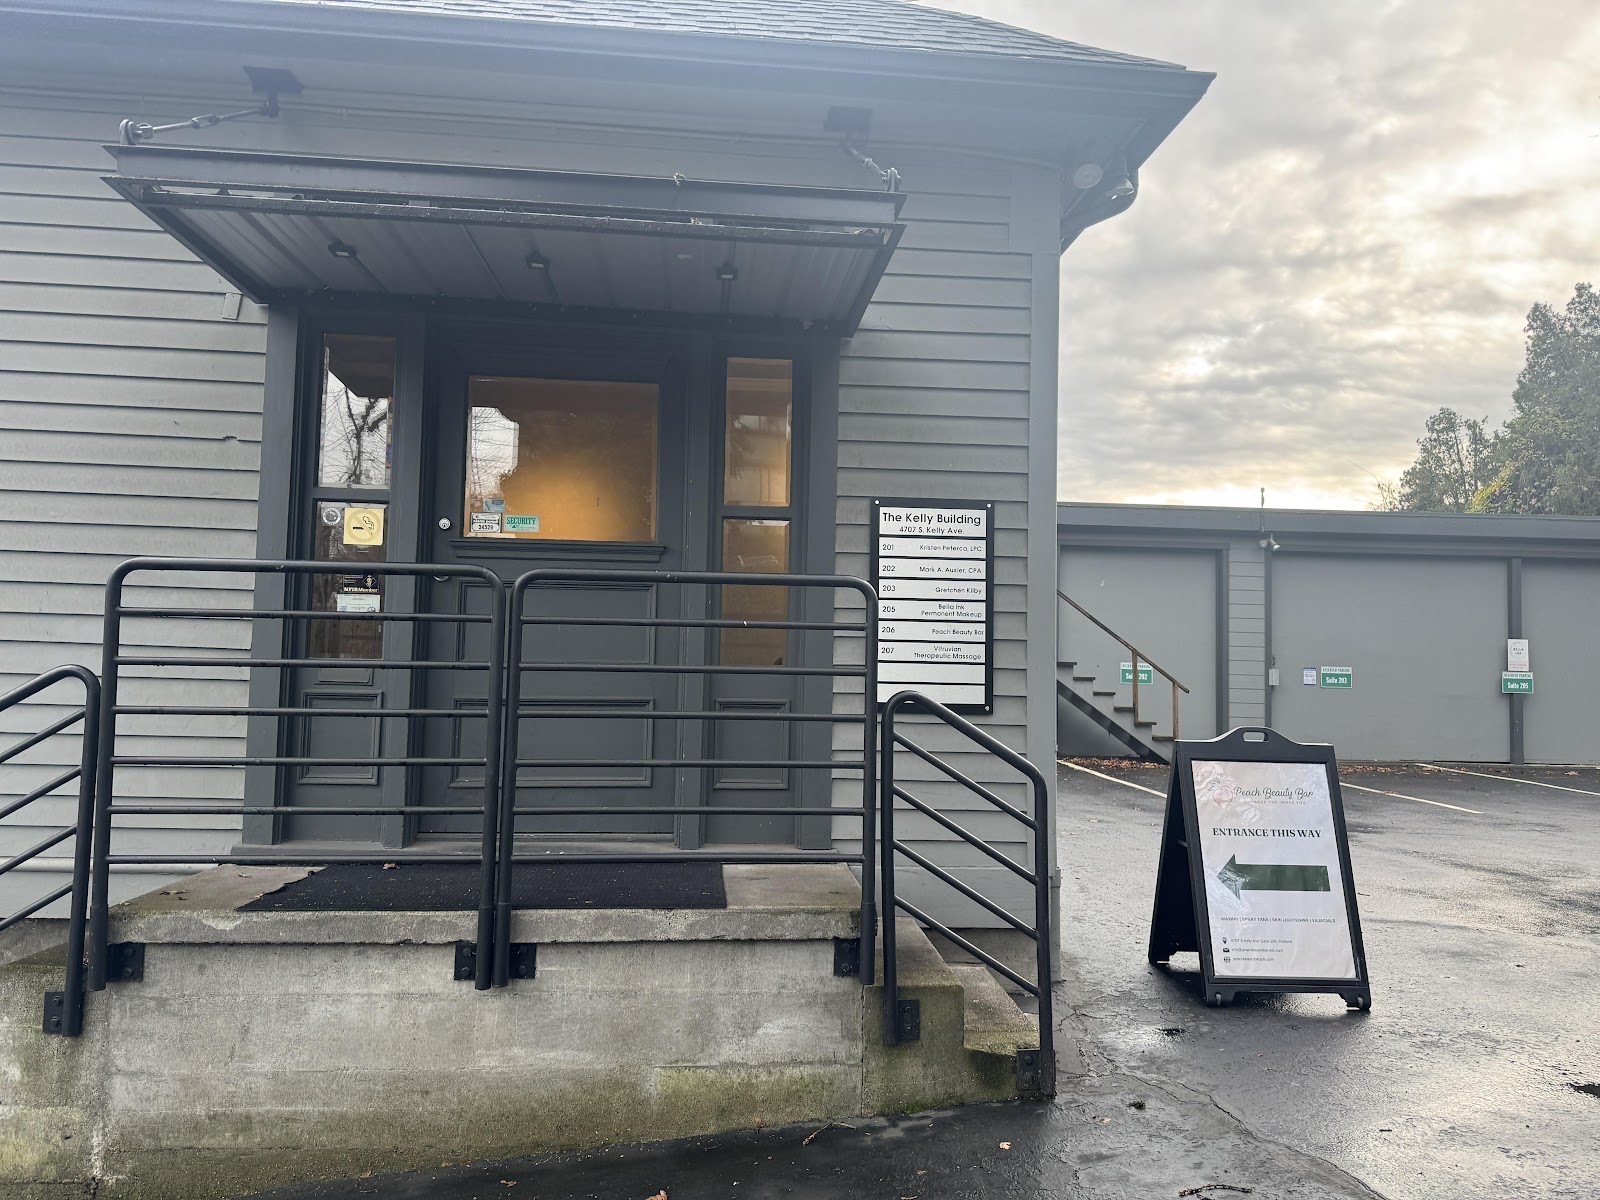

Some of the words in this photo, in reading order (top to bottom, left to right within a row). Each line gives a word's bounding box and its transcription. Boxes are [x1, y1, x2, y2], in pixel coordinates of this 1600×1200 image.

[506, 516, 537, 525] SECURITY
[882, 512, 902, 522] The
[905, 513, 934, 525] Kelly
[937, 514, 981, 527] Building
[926, 527, 946, 535] Kelly
[956, 611, 983, 619] Makeup
[881, 626, 896, 634] 206
[913, 652, 951, 660] Therapeutic
[1325, 676, 1338, 684] Suite
[1507, 681, 1520, 689] Suite
[1234, 786, 1261, 797] Peach
[1262, 786, 1293, 800] Beauty
[1294, 787, 1314, 800] Bar
[1212, 827, 1269, 837] ENTRANCE
[1269, 828, 1296, 838] THIS
[1296, 829, 1322, 838] WAY
